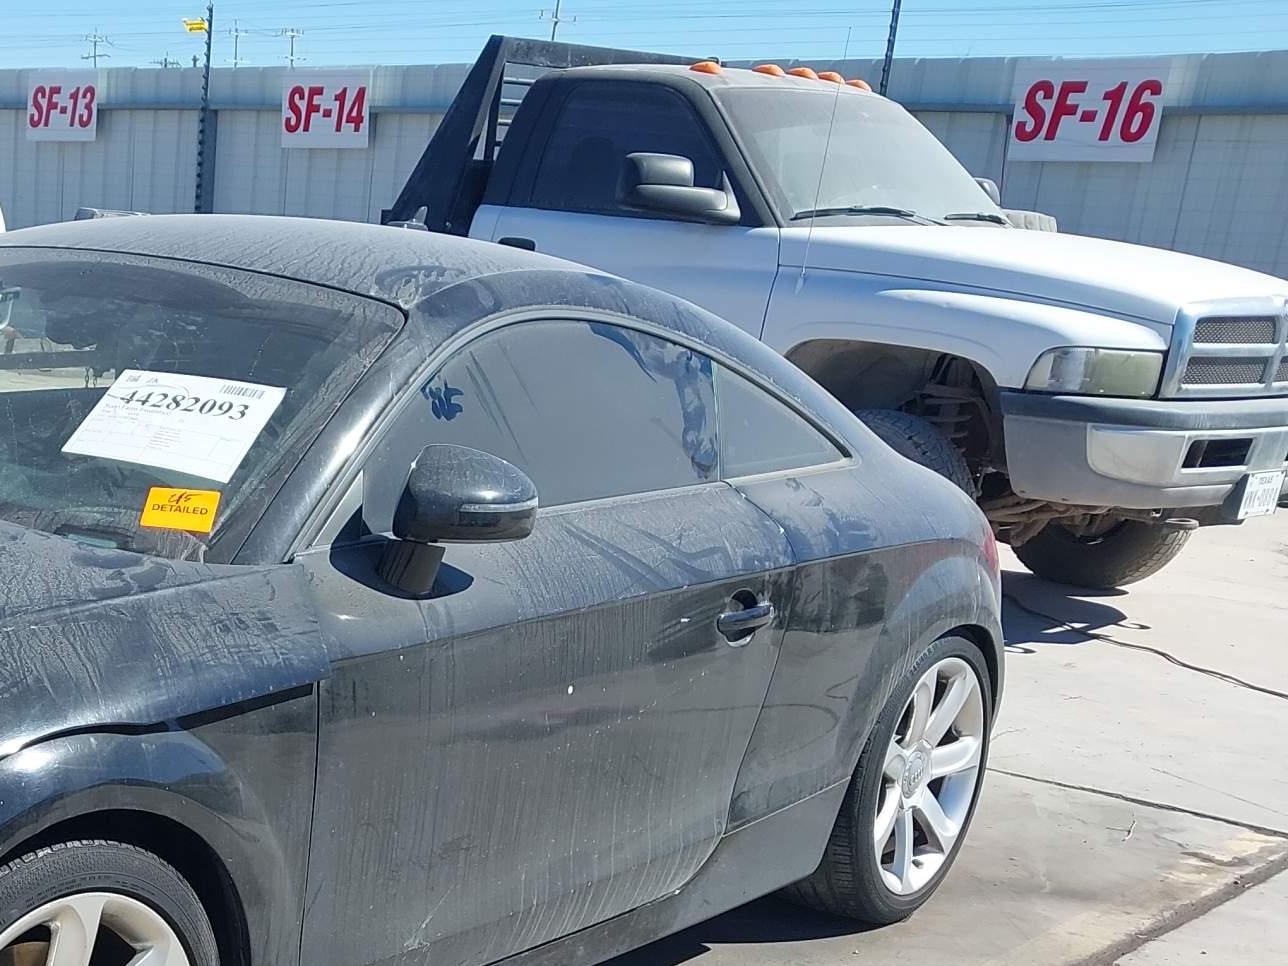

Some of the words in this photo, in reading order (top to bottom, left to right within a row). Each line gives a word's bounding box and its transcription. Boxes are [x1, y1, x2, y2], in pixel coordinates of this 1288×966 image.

[29, 85, 96, 128] SF-13
[284, 85, 367, 133] SF-14
[1015, 79, 1162, 142] SF-16
[119, 389, 251, 421] 44282093
[151, 503, 209, 516] DETAILED
